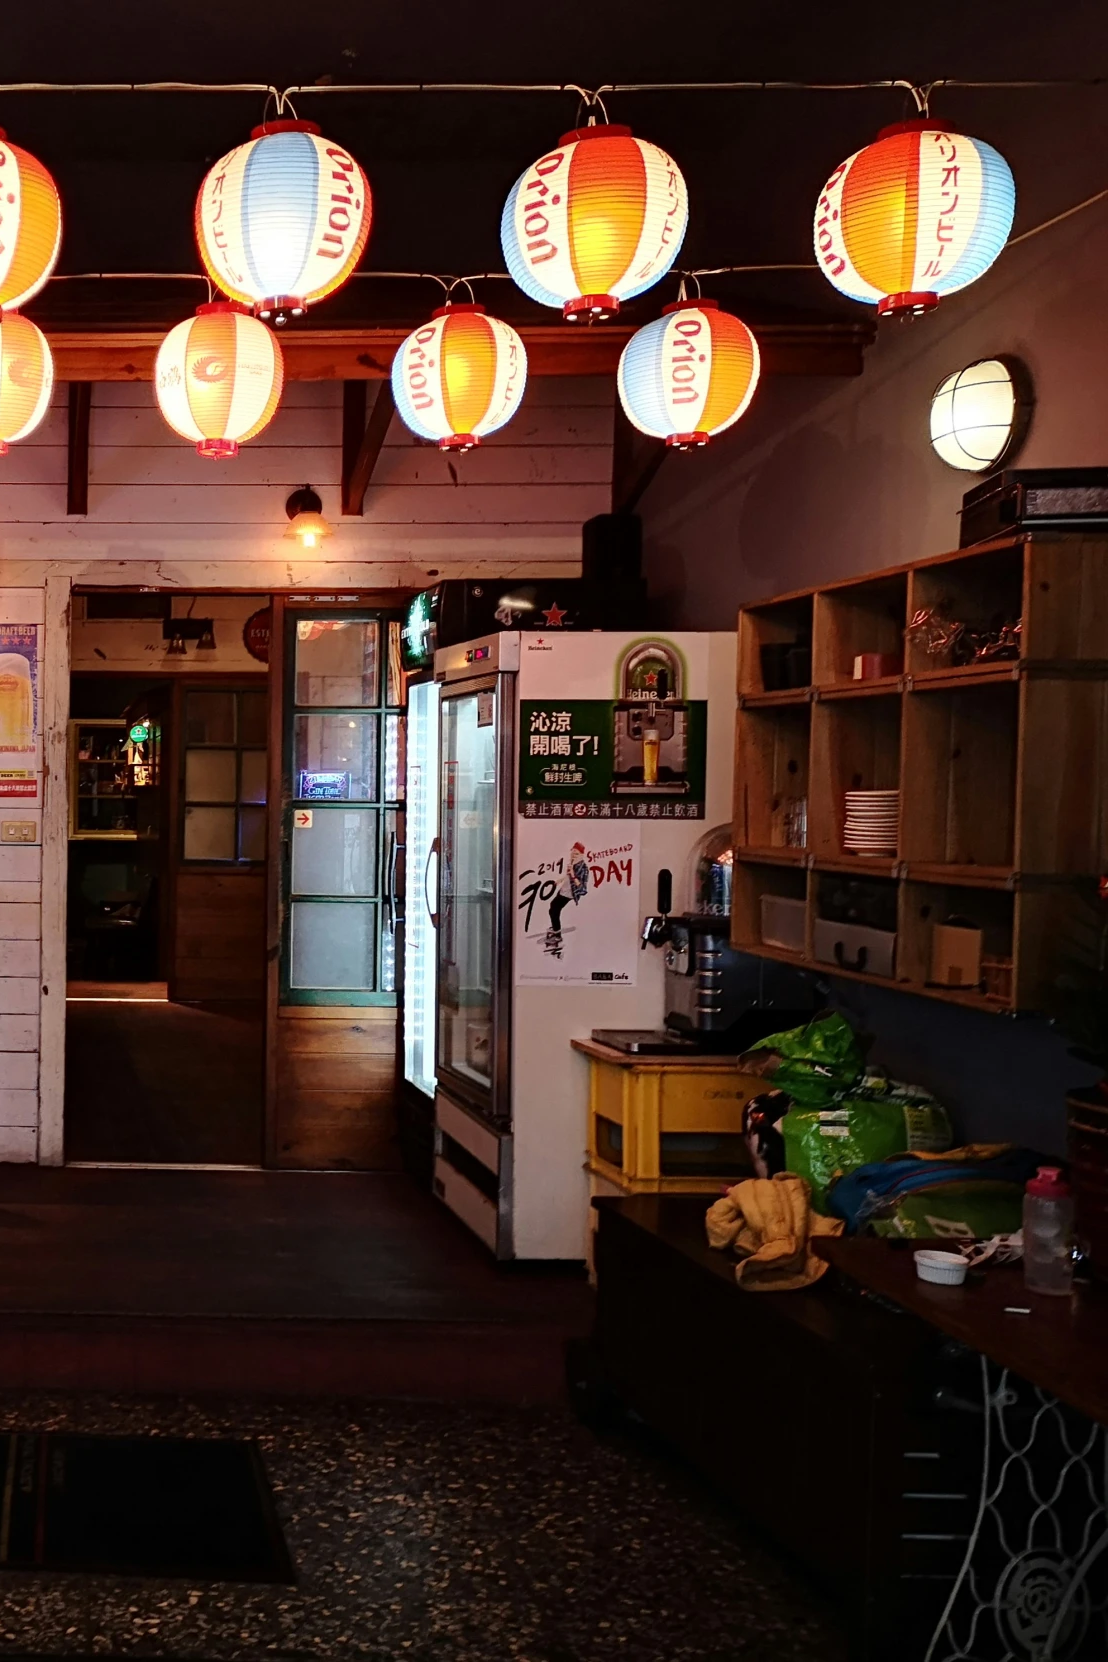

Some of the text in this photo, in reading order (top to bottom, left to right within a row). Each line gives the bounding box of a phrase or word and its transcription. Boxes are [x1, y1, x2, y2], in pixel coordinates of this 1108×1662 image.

[212, 144, 244, 284] リオンビール
[316, 148, 361, 259] Orion
[524, 152, 565, 265] Orion
[634, 148, 679, 279] リオンビール
[408, 325, 437, 411] Orion
[672, 320, 706, 405] Orion
[530, 712, 572, 732] 沁涼
[627, 688, 676, 700] Heineen
[544, 771, 583, 784] 鮮封生啤
[525, 803, 699, 817] 禁止酒駕 未滿十八歲禁止飲酒
[587, 843, 634, 862] SKATEBOARD
[589, 858, 633, 888] DAY
